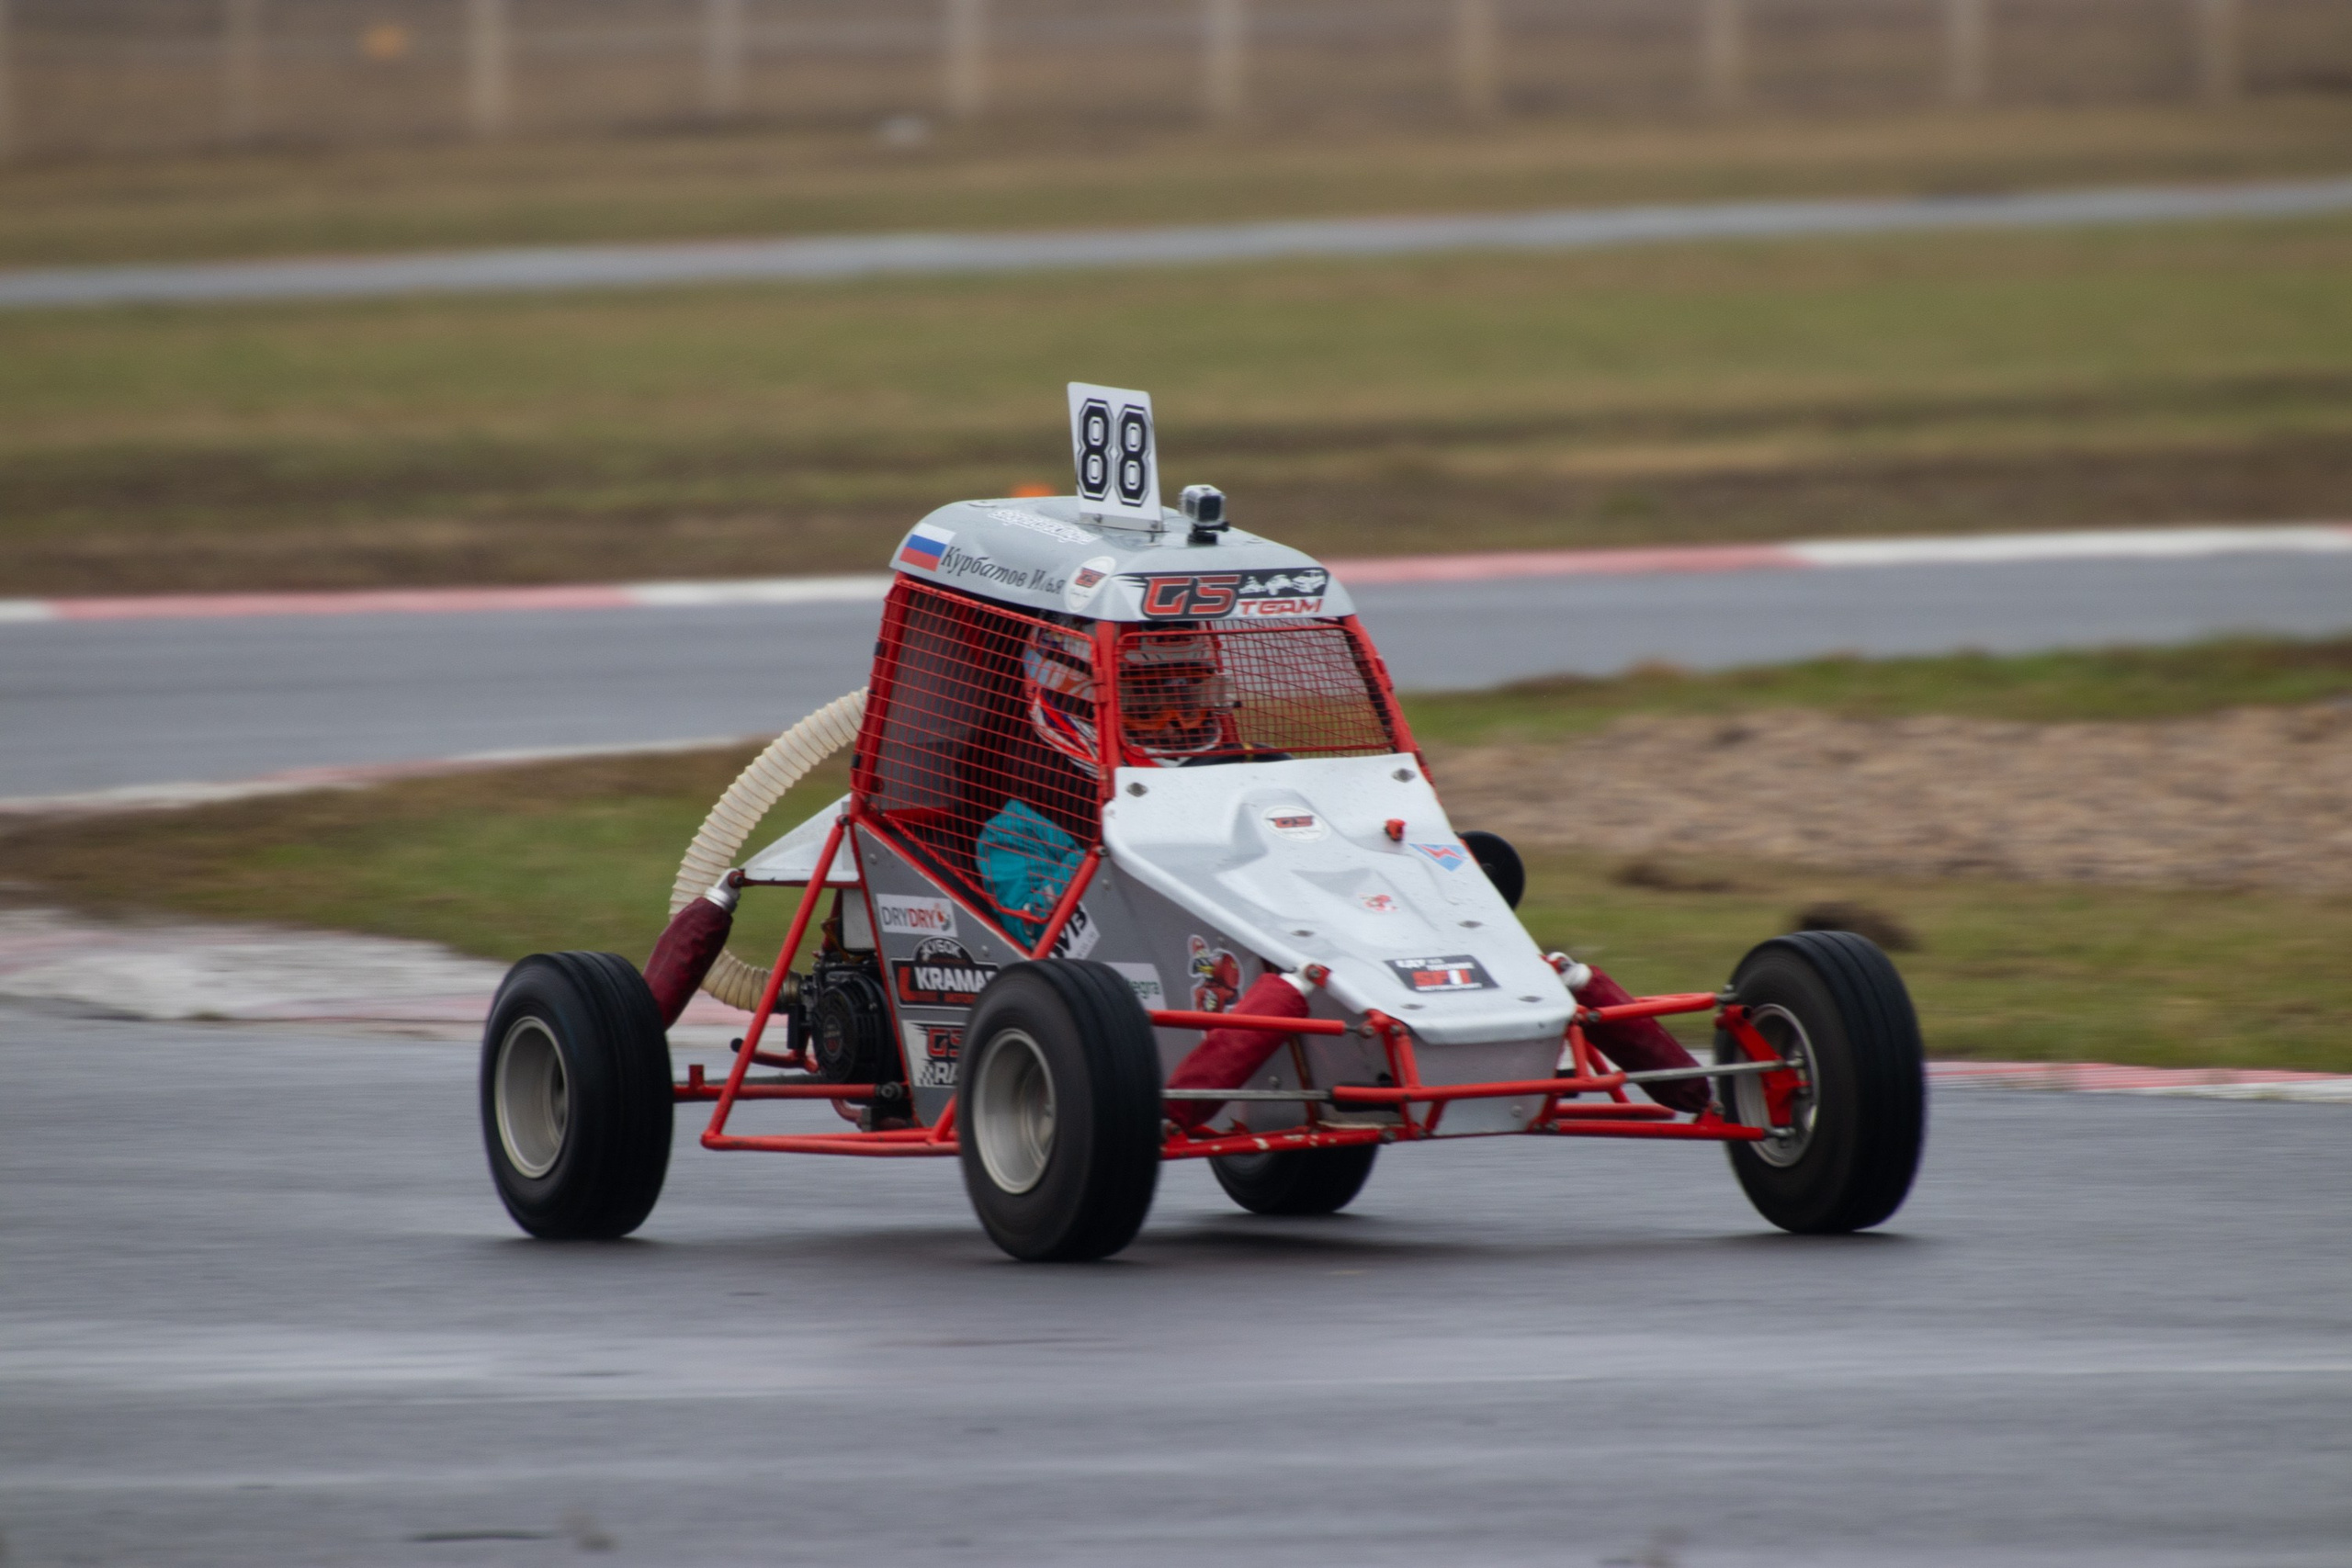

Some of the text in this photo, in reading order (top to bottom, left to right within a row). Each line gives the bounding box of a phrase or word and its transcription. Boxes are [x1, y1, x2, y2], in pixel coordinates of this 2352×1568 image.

[1077, 398, 1150, 508] 88
[941, 547, 1027, 587] Курбатов
[1143, 574, 1241, 615] GS
[1239, 599, 1323, 615] TEAM
[881, 907, 936, 929] DRYDRY
